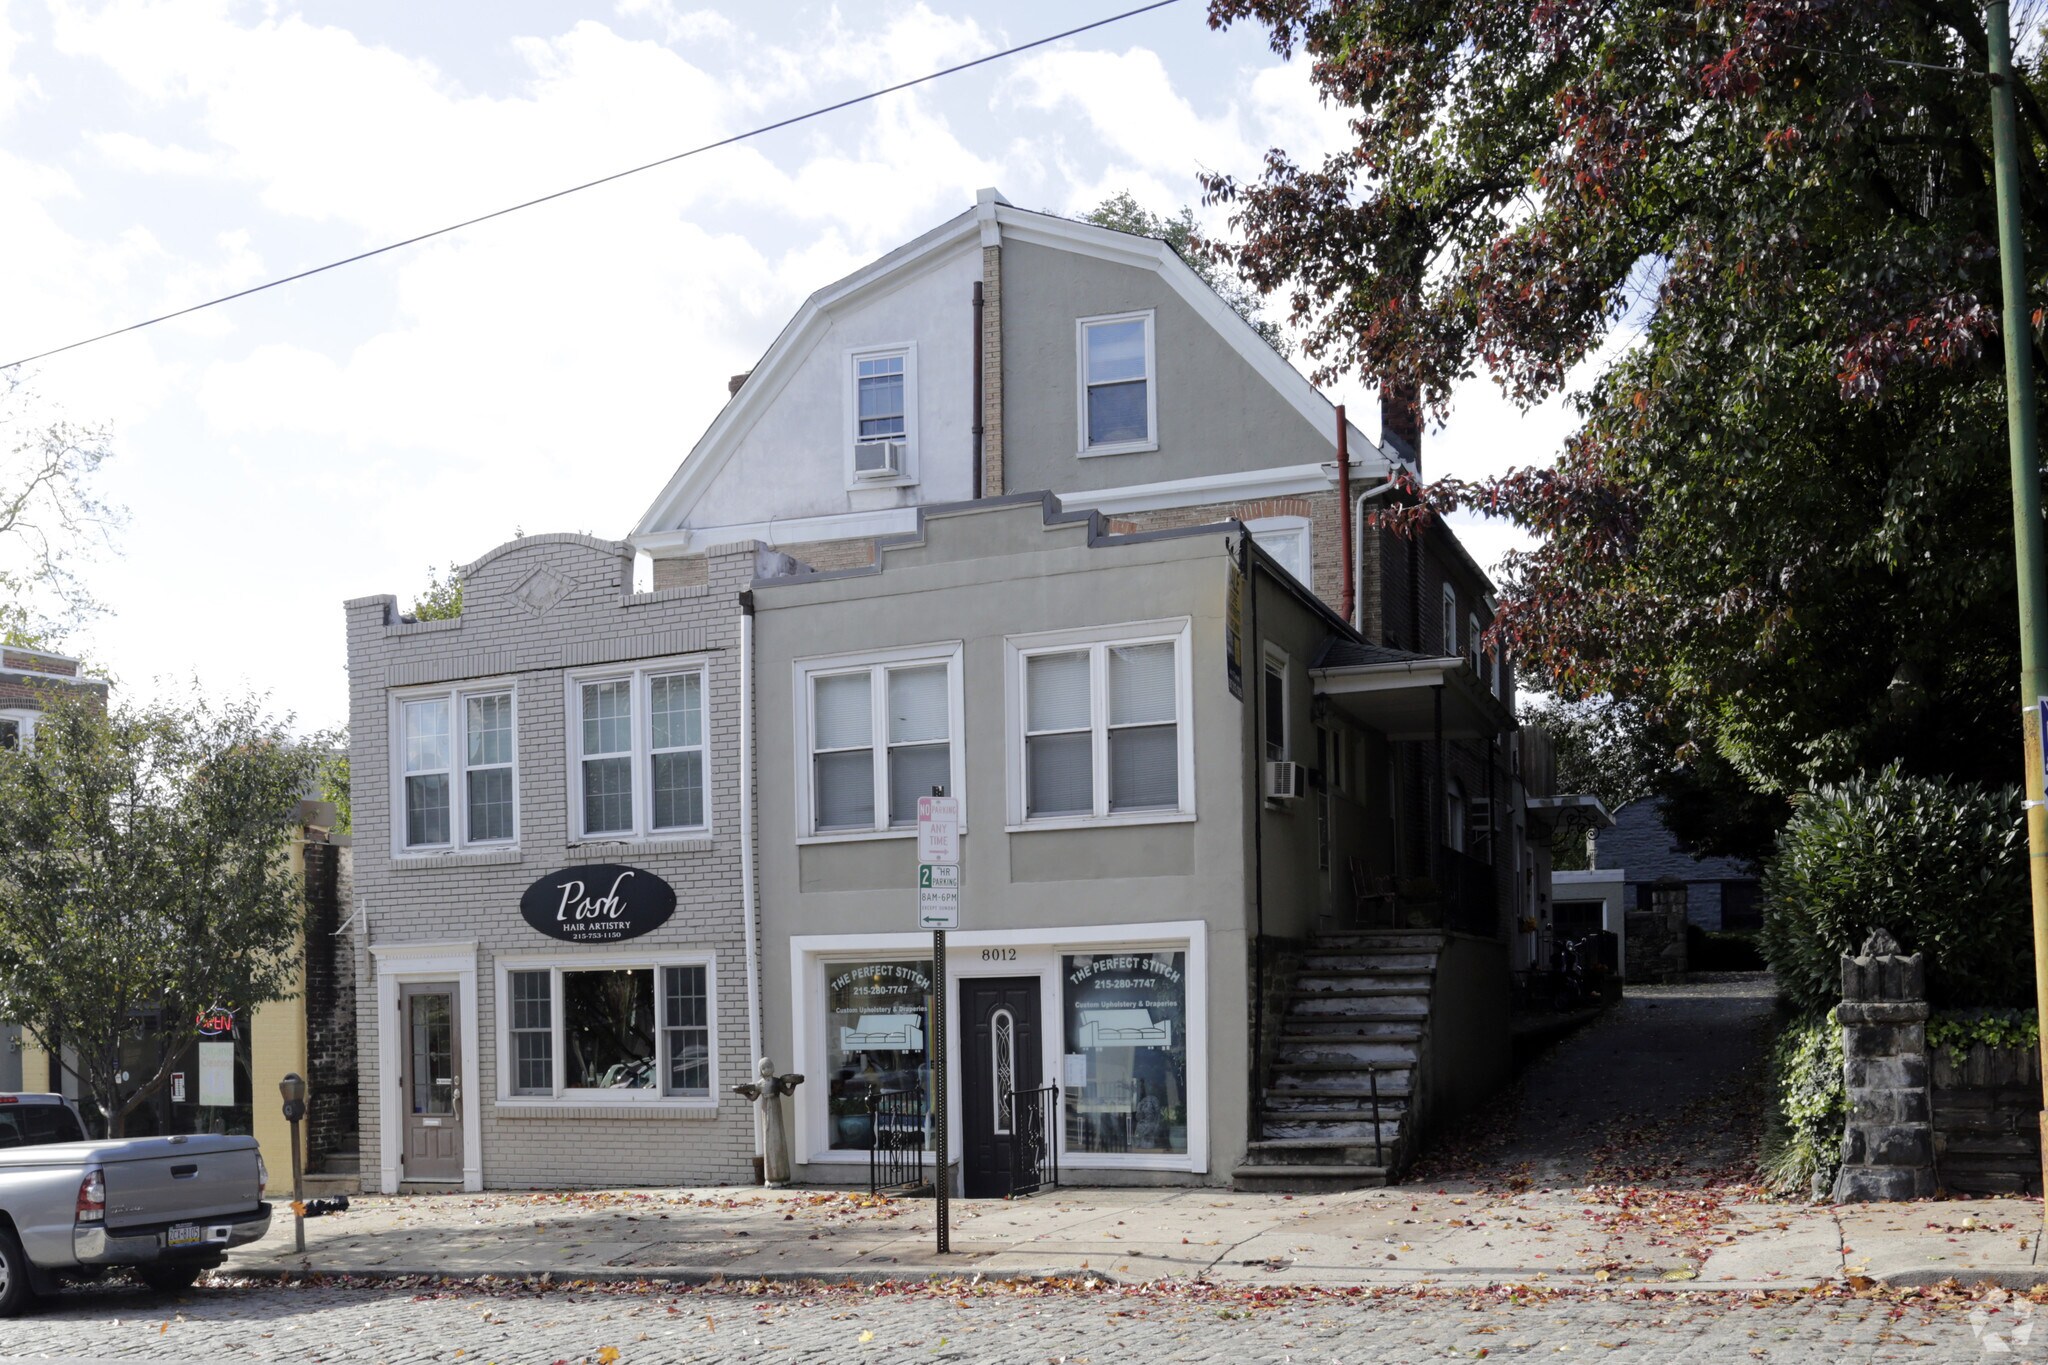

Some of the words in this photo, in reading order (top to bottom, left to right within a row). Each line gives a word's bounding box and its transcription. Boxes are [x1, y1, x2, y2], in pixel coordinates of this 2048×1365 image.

[920, 803, 930, 816] NO
[932, 806, 956, 815] PARKING
[930, 824, 947, 834] ANY
[930, 836, 948, 846] TIME
[922, 868, 930, 885] 2
[940, 868, 951, 876] HR
[932, 877, 957, 886] PARKING
[556, 871, 635, 921] Posh
[563, 923, 585, 932] HAIR
[588, 921, 631, 930] ARTISTRY
[573, 931, 622, 940] 215-753-1150
[982, 948, 1017, 961] 8012
[1070, 965, 1092, 985] THE
[1092, 957, 1140, 974] PERFECT
[1142, 958, 1181, 983] STITCH
[831, 973, 851, 991] THE
[851, 965, 894, 980] PERFECT
[895, 966, 931, 990] STITCH
[1094, 979, 1156, 989] 215-280-7747
[853, 985, 909, 995] 215-280-7747
[835, 1006, 860, 1014] Custom
[860, 1006, 892, 1014] Upholstery
[899, 1004, 928, 1013] Draperies
[1101, 1001, 1137, 1009] Upholstery
[1145, 1000, 1178, 1008] Draperies
